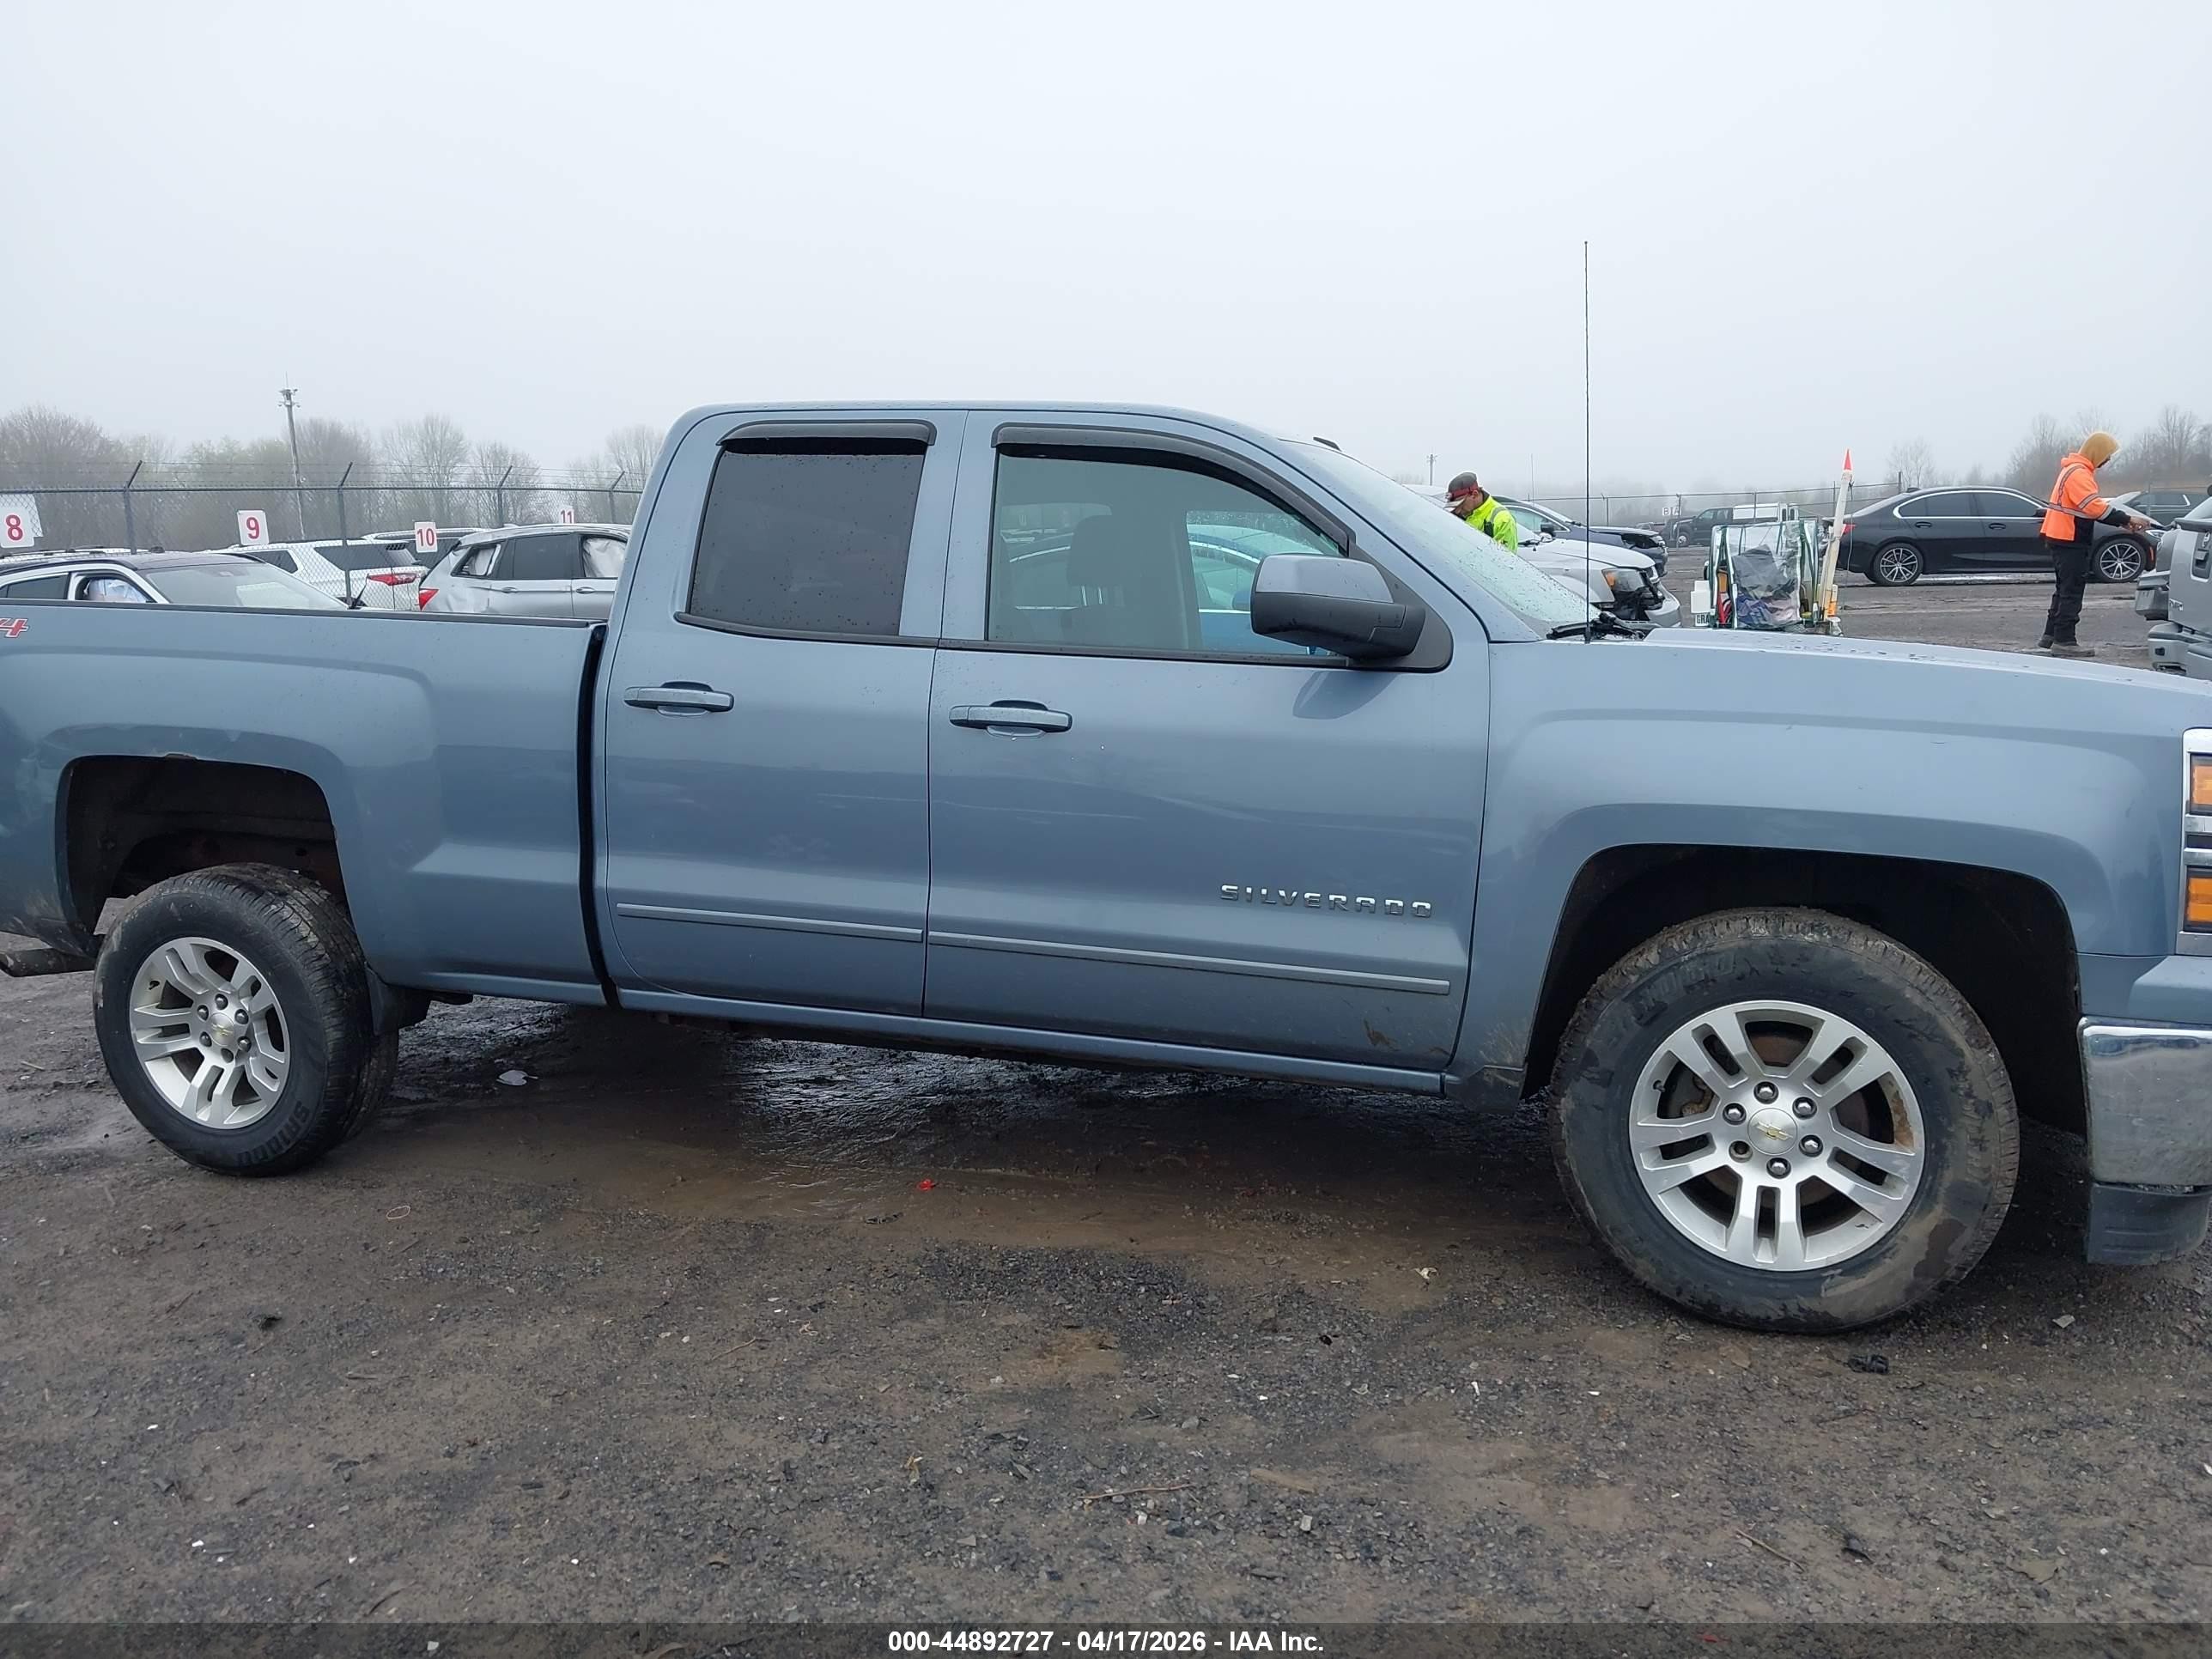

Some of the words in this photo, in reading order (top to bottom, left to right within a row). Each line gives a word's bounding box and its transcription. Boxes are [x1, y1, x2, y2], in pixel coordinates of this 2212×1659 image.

[5, 514, 24, 542] 8
[246, 516, 260, 540] 9
[560, 509, 573, 524] 11
[416, 527, 435, 547] 10
[1220, 884, 1432, 918] SILVERADO
